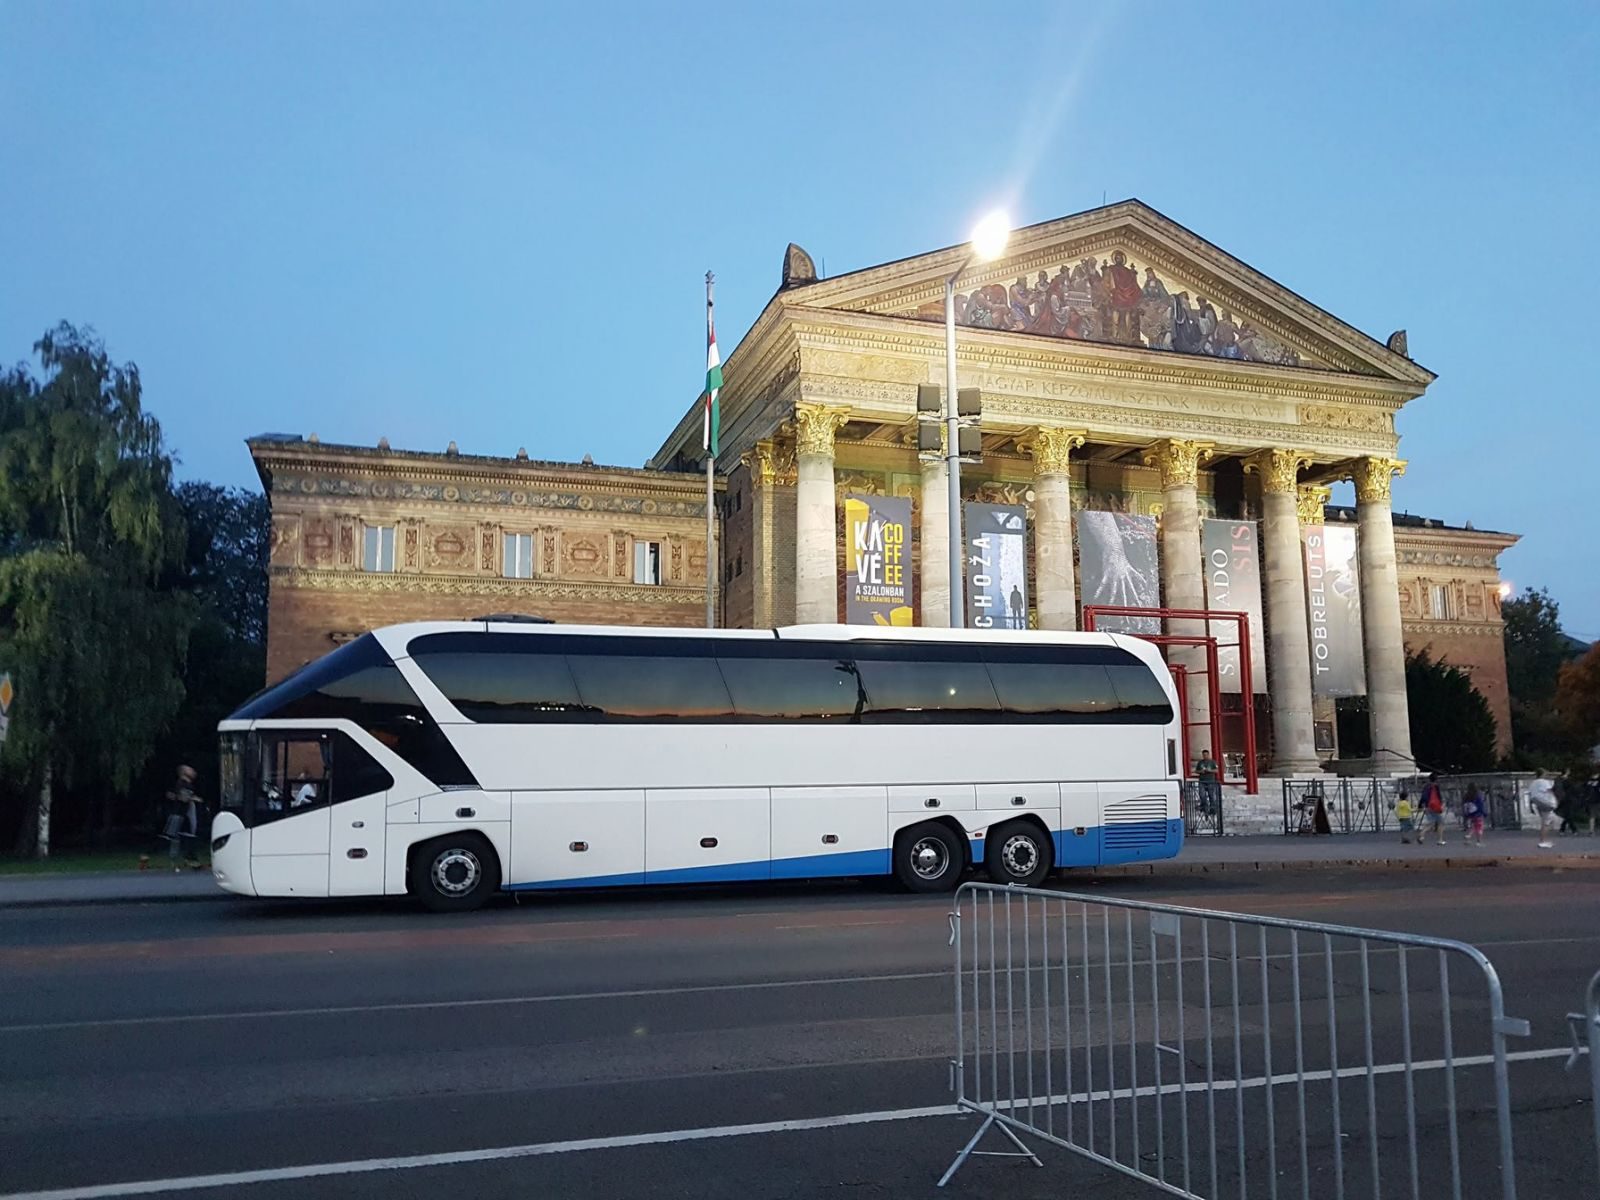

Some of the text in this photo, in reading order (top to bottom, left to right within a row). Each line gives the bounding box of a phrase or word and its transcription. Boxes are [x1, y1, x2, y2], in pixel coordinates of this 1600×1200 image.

[884, 523, 904, 544] CO
[884, 544, 903, 565] FF
[855, 552, 882, 584] VÉ
[885, 565, 904, 586] EE
[855, 585, 905, 597] A SZALONBAN
[1308, 535, 1330, 676] TOBRELUTS
